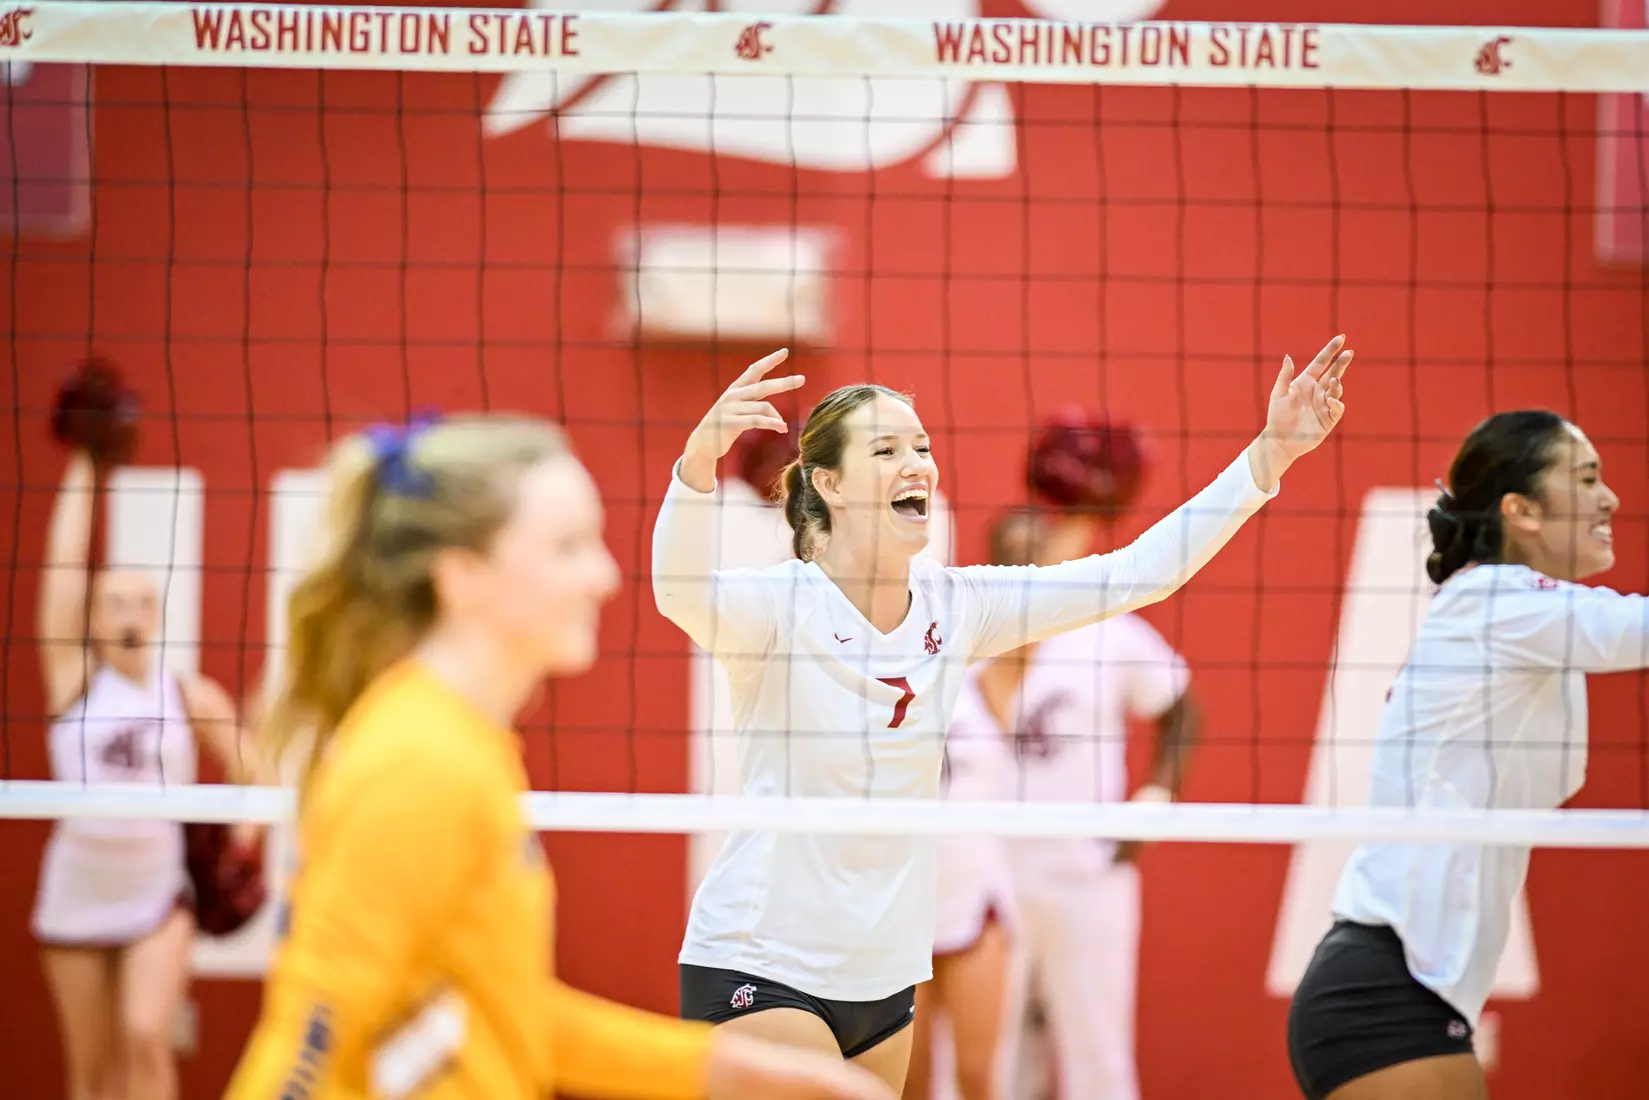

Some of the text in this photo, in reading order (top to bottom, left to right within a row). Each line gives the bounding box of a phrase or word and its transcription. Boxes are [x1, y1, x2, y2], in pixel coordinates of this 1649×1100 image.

[193, 9, 580, 56] WASHINGTON STATE
[934, 21, 1320, 69] WASHINGTON STATE
[875, 676, 916, 729] 7
